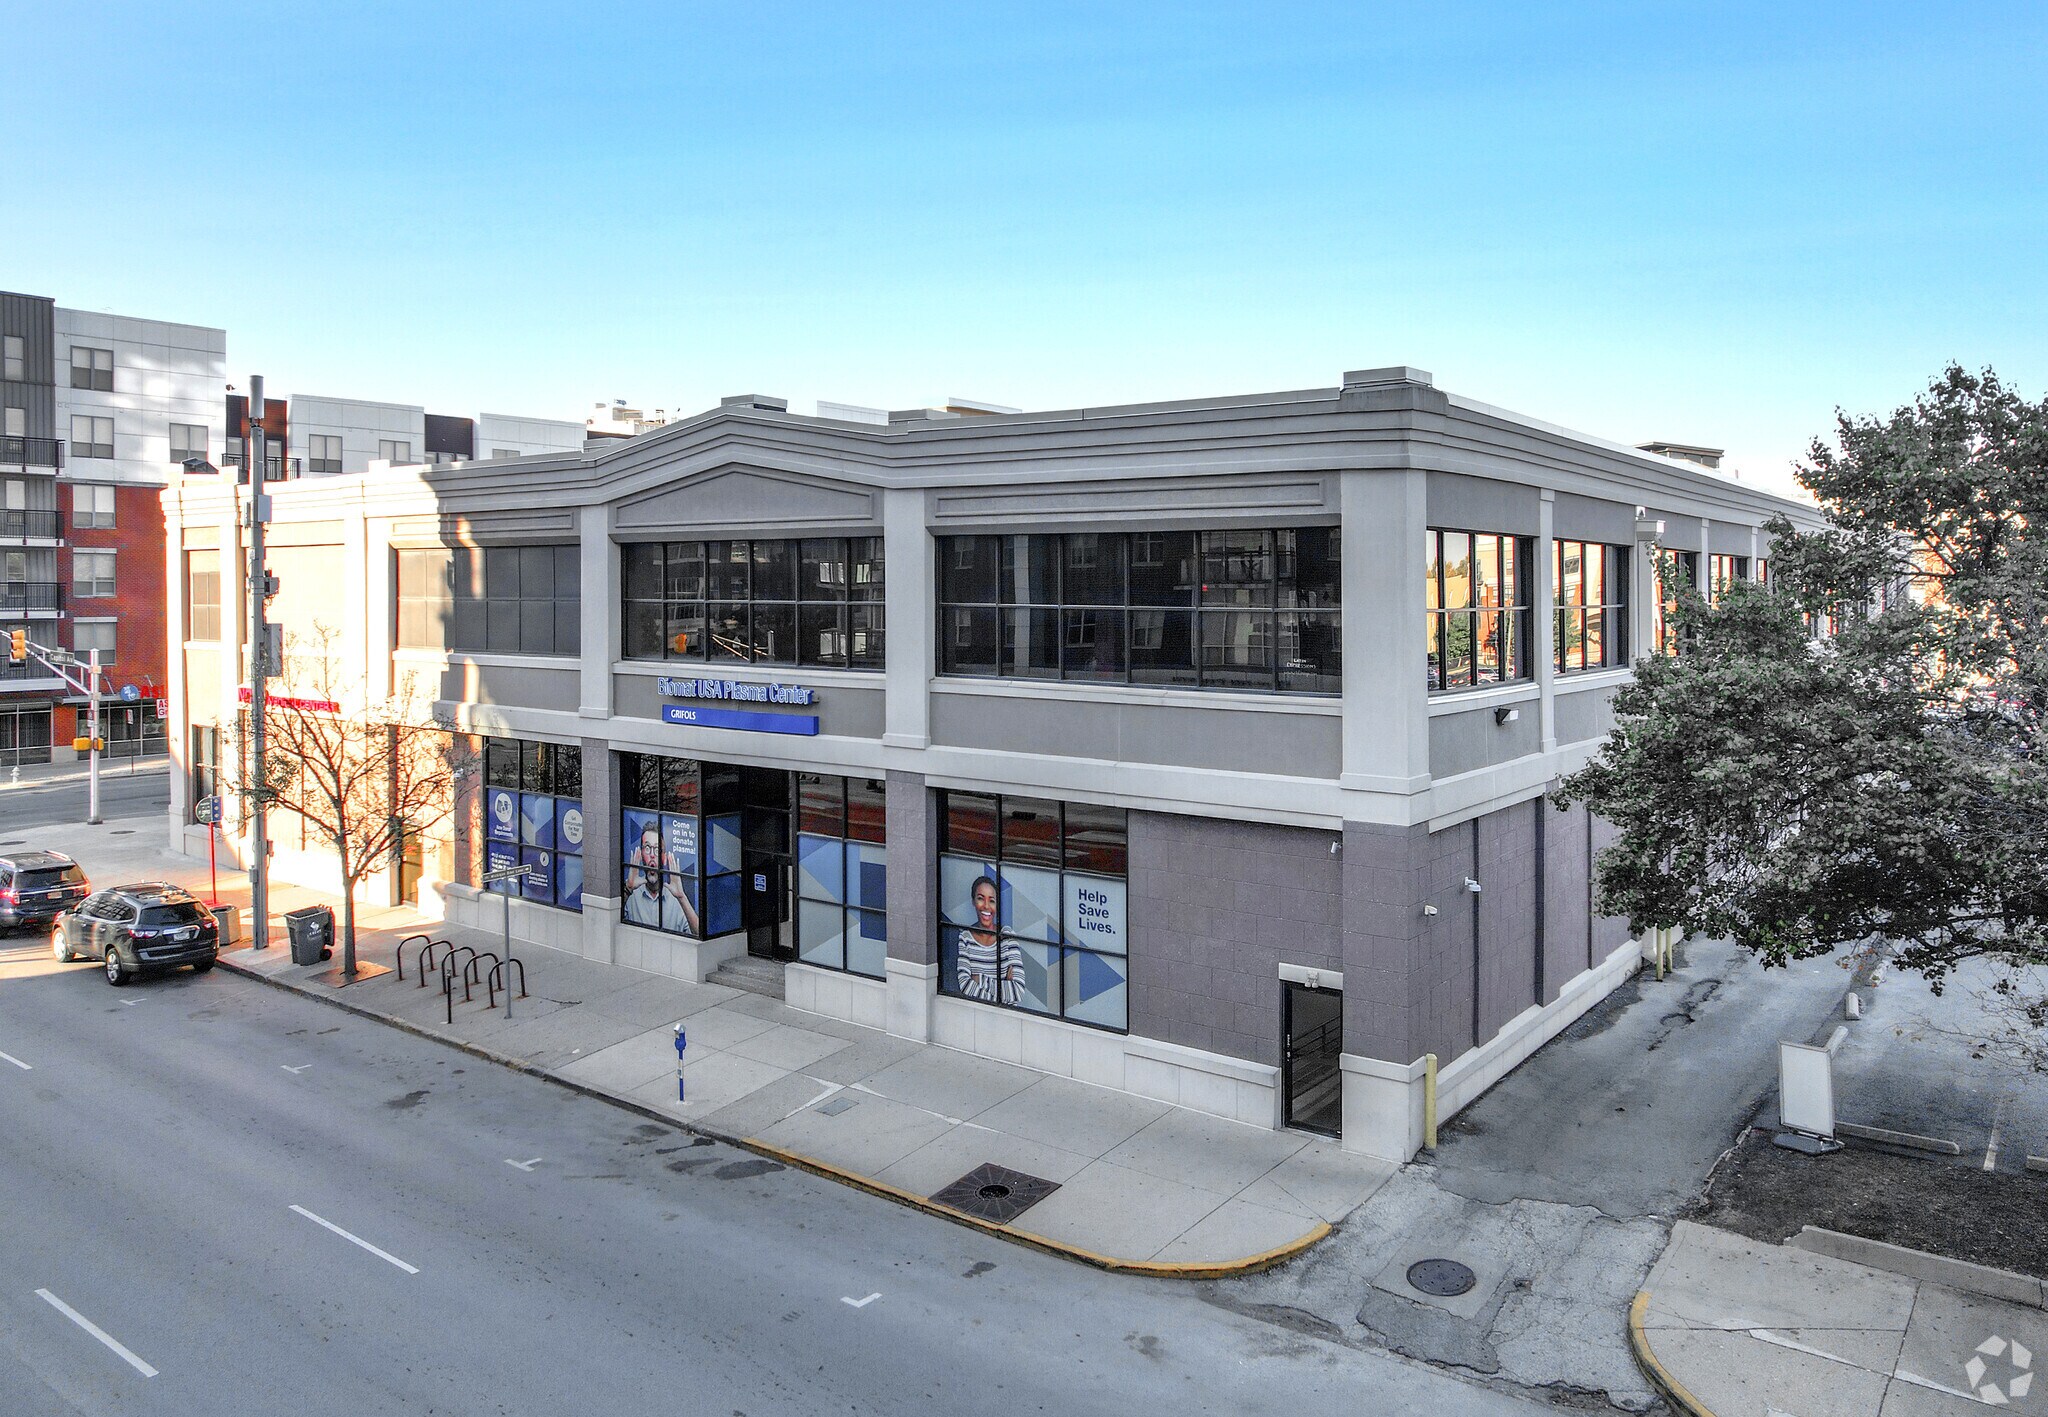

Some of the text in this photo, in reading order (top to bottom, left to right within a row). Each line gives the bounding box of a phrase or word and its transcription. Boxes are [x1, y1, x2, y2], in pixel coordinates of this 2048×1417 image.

[657, 677, 812, 705] Biomat USA Plasma Center
[670, 709, 697, 721] GRIFOLS
[672, 819, 690, 829] Come
[672, 836, 693, 846] donate
[672, 845, 696, 854] plasma!
[1078, 888, 1108, 905] Help
[1078, 903, 1110, 919] Save
[1078, 917, 1117, 935] Lives.
